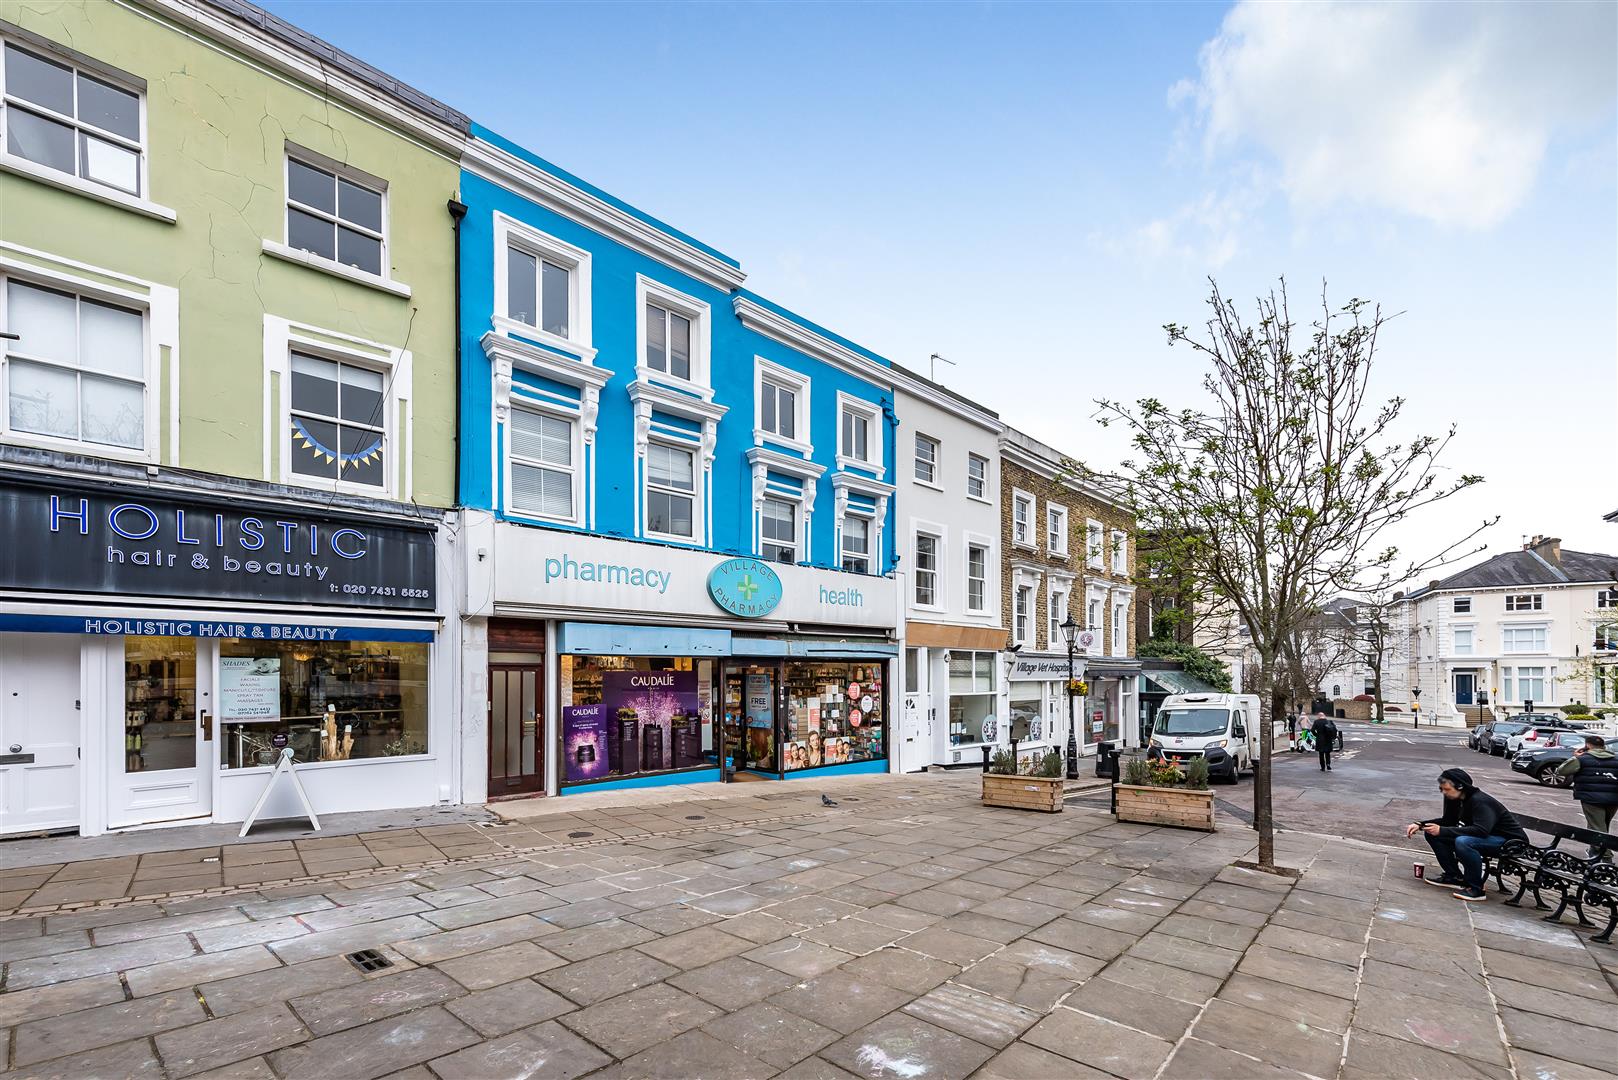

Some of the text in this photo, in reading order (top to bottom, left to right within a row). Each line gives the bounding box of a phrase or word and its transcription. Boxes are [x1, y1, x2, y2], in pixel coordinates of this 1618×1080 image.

[49, 494, 367, 559] HOLISTIC
[107, 545, 329, 581] hair & beauty
[545, 554, 672, 595] pharmacy
[720, 559, 775, 582] VILLAGE
[342, 584, 367, 594] 020
[370, 585, 396, 596] 7431
[401, 588, 429, 599] 5525
[713, 586, 780, 614] PHARMACY
[819, 584, 864, 608] health
[84, 619, 338, 641] HOLISTIC HAIR & BEAUTY
[1016, 661, 1037, 675] Village
[1038, 662, 1048, 673] Vet
[750, 697, 766, 705] FREE
